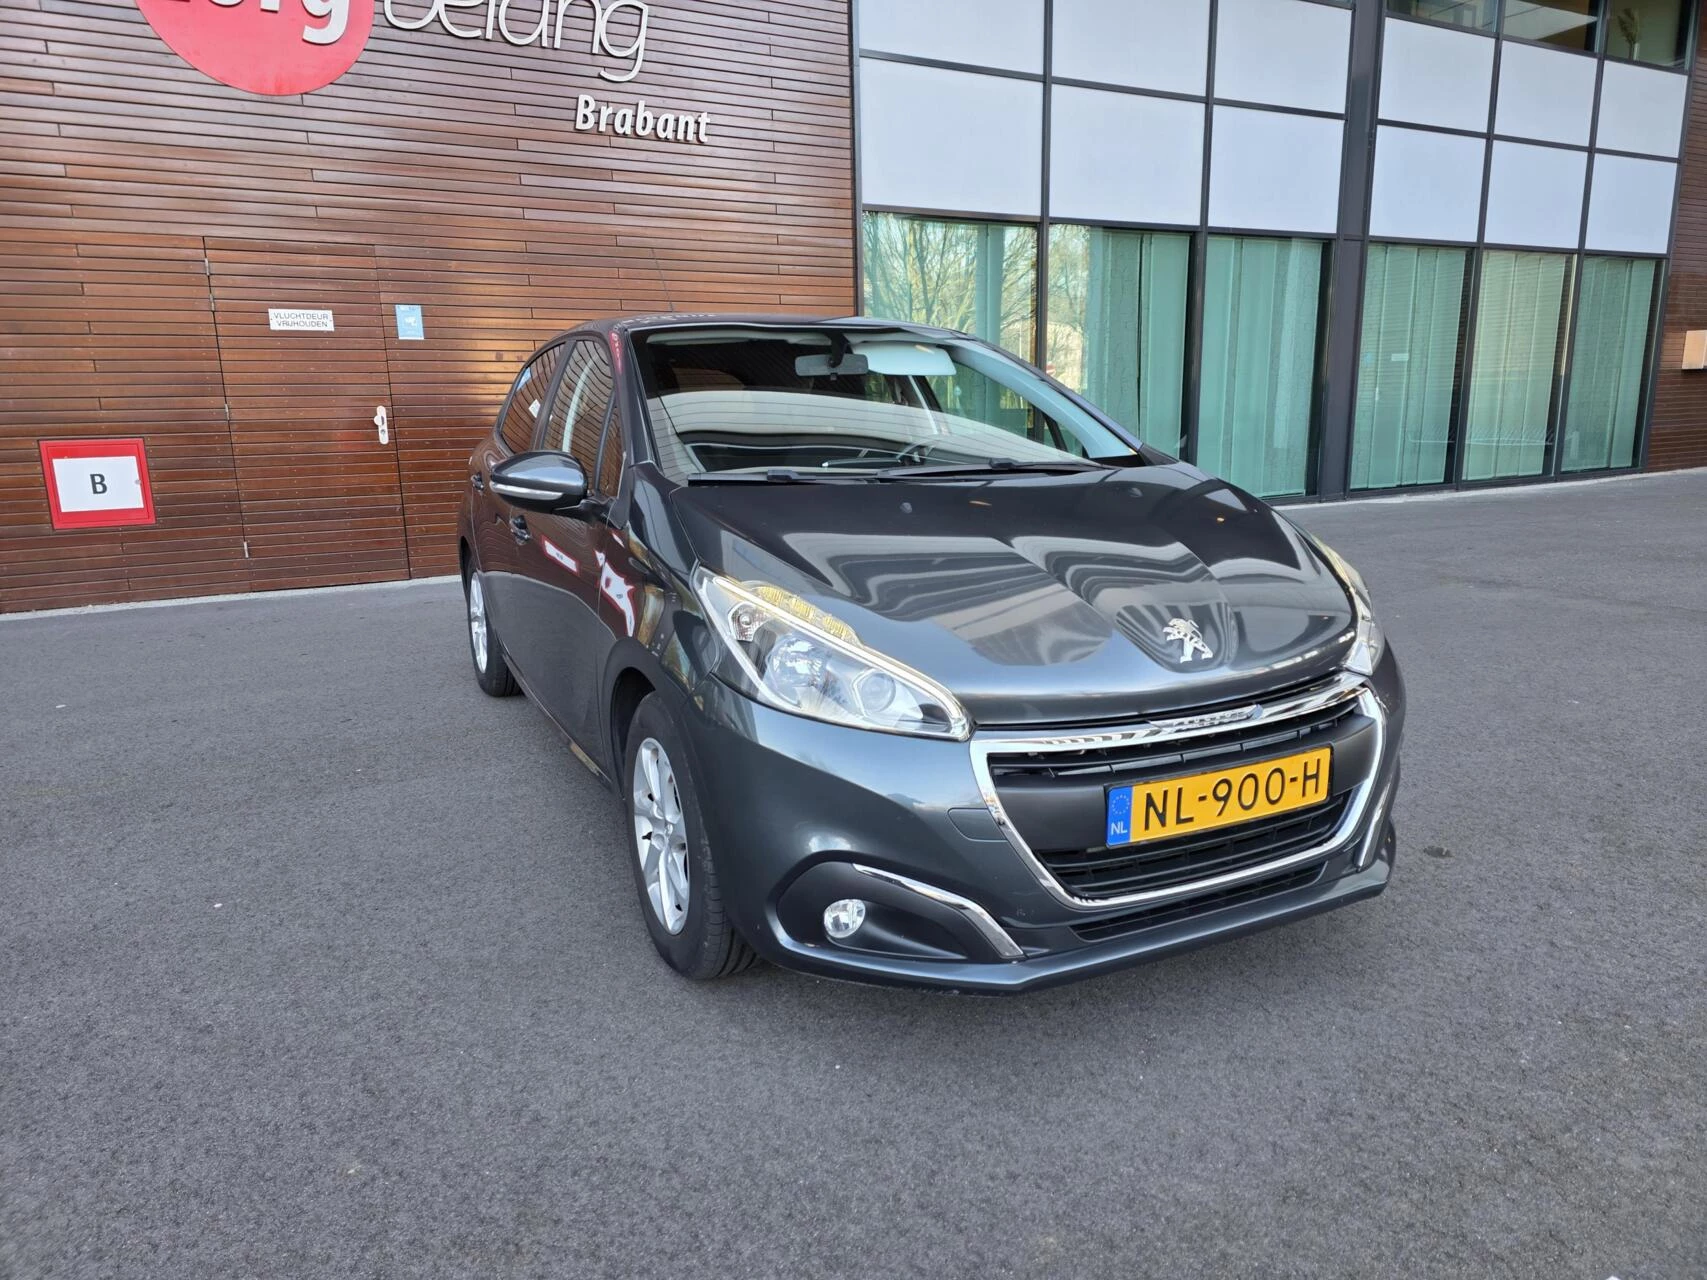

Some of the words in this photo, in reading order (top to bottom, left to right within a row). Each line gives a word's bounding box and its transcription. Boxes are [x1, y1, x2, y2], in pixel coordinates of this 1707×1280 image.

[575, 94, 710, 143] Brabant
[273, 311, 329, 320] VLUCHTDEUR
[90, 473, 108, 495] B
[1144, 758, 1321, 831] NL-900-H
[1110, 820, 1128, 835] NL
